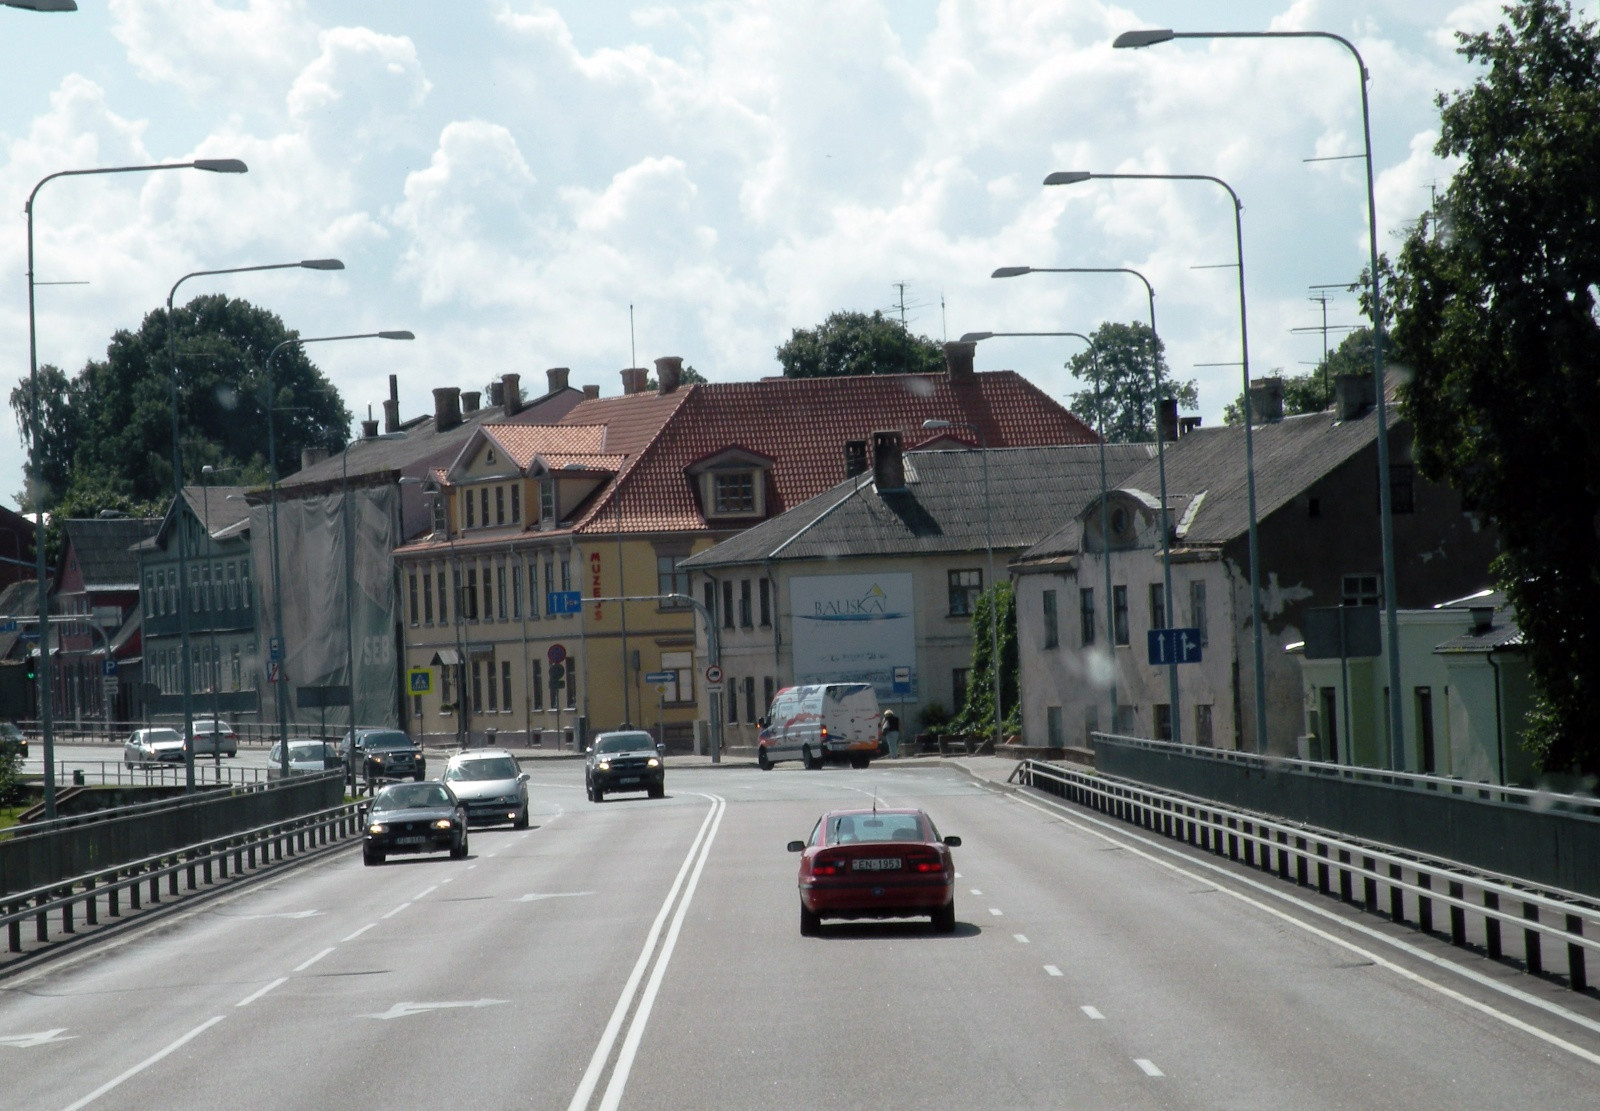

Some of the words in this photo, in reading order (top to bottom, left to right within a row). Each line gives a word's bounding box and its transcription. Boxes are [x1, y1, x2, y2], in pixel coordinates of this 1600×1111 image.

[815, 598, 884, 616] BAUSKA
[363, 636, 391, 665] SEB
[105, 661, 116, 673] P
